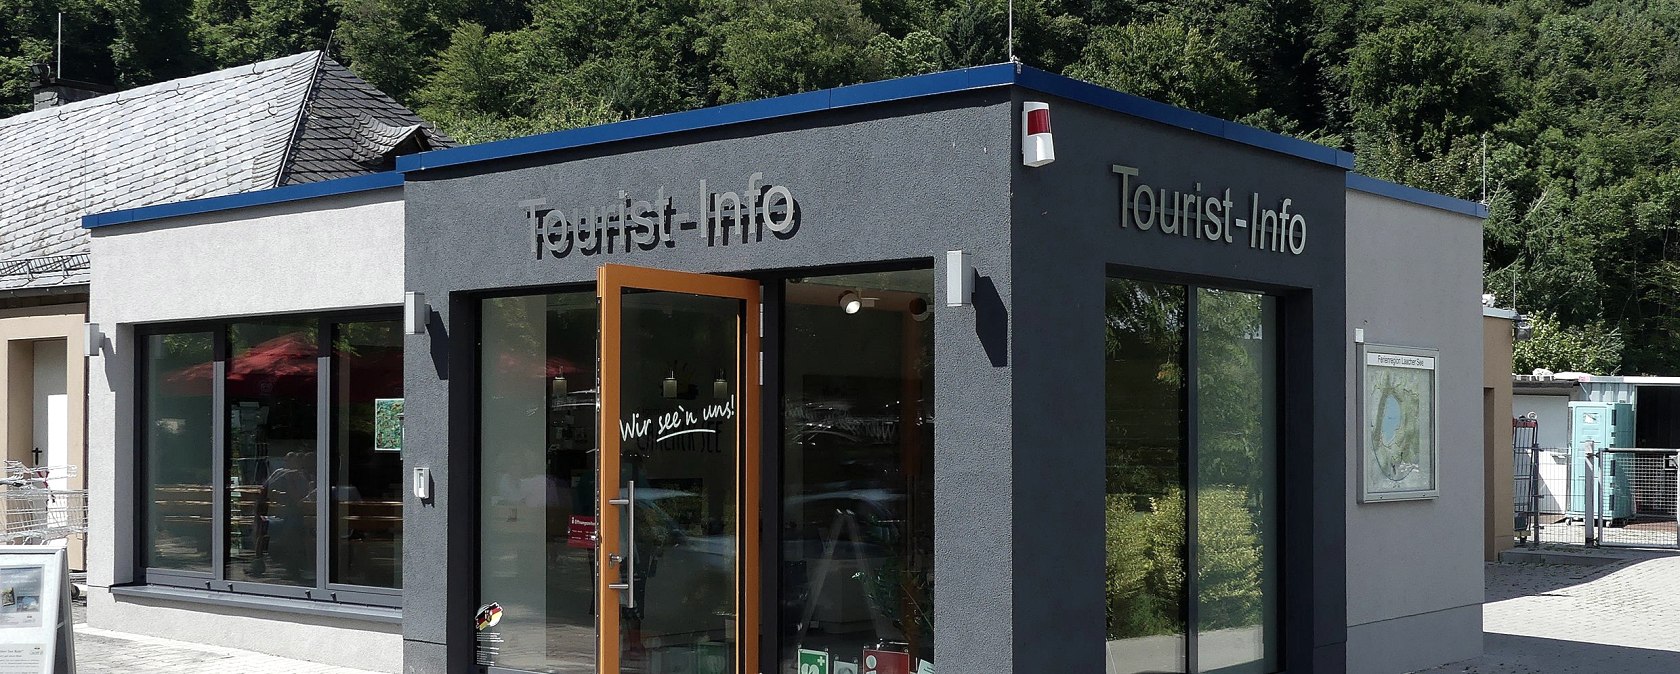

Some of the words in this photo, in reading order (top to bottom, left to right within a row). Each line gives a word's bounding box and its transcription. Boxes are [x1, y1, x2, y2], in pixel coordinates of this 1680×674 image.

[518, 171, 794, 253] Tourist-Info
[1112, 164, 1306, 255] Tourist-Info
[619, 413, 652, 442] Wir
[703, 394, 735, 419] uns!
